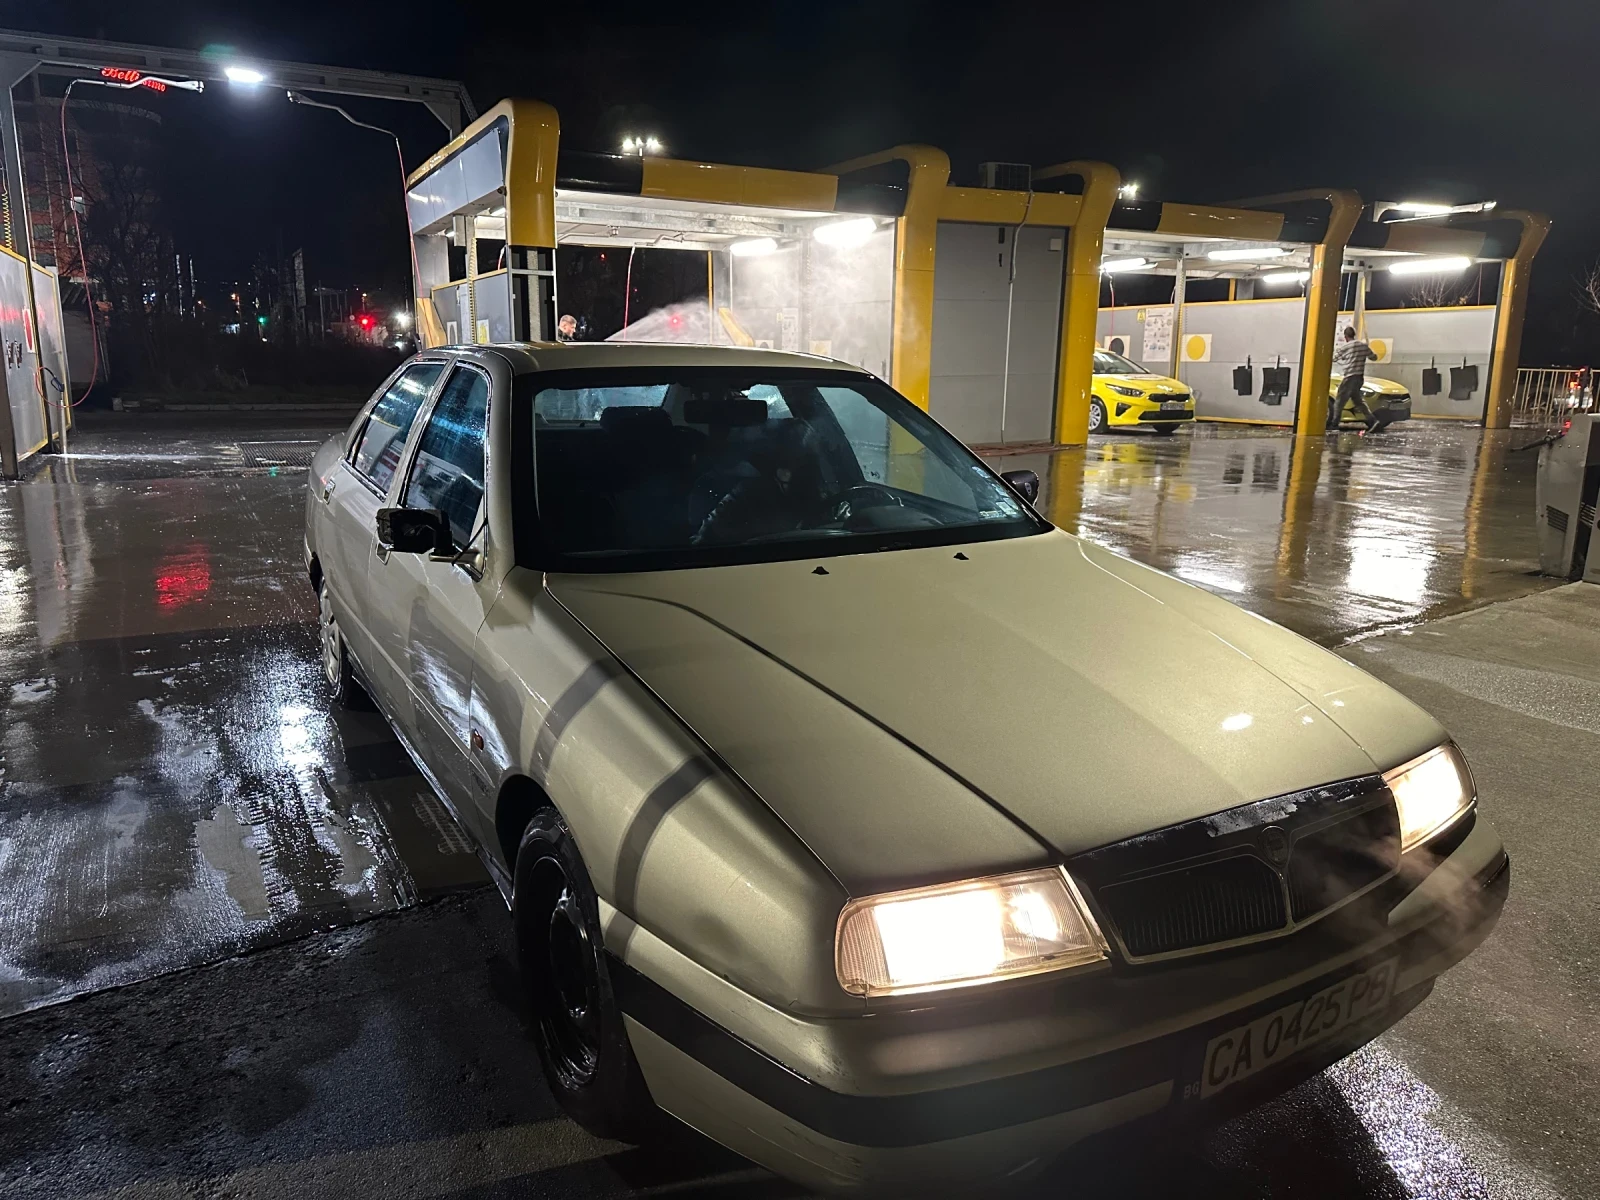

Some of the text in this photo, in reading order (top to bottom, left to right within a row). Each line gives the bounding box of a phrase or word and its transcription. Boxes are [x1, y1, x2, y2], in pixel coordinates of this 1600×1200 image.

[1208, 965, 1391, 1087] CA 0425 PB
[1184, 1081, 1200, 1100] BG
